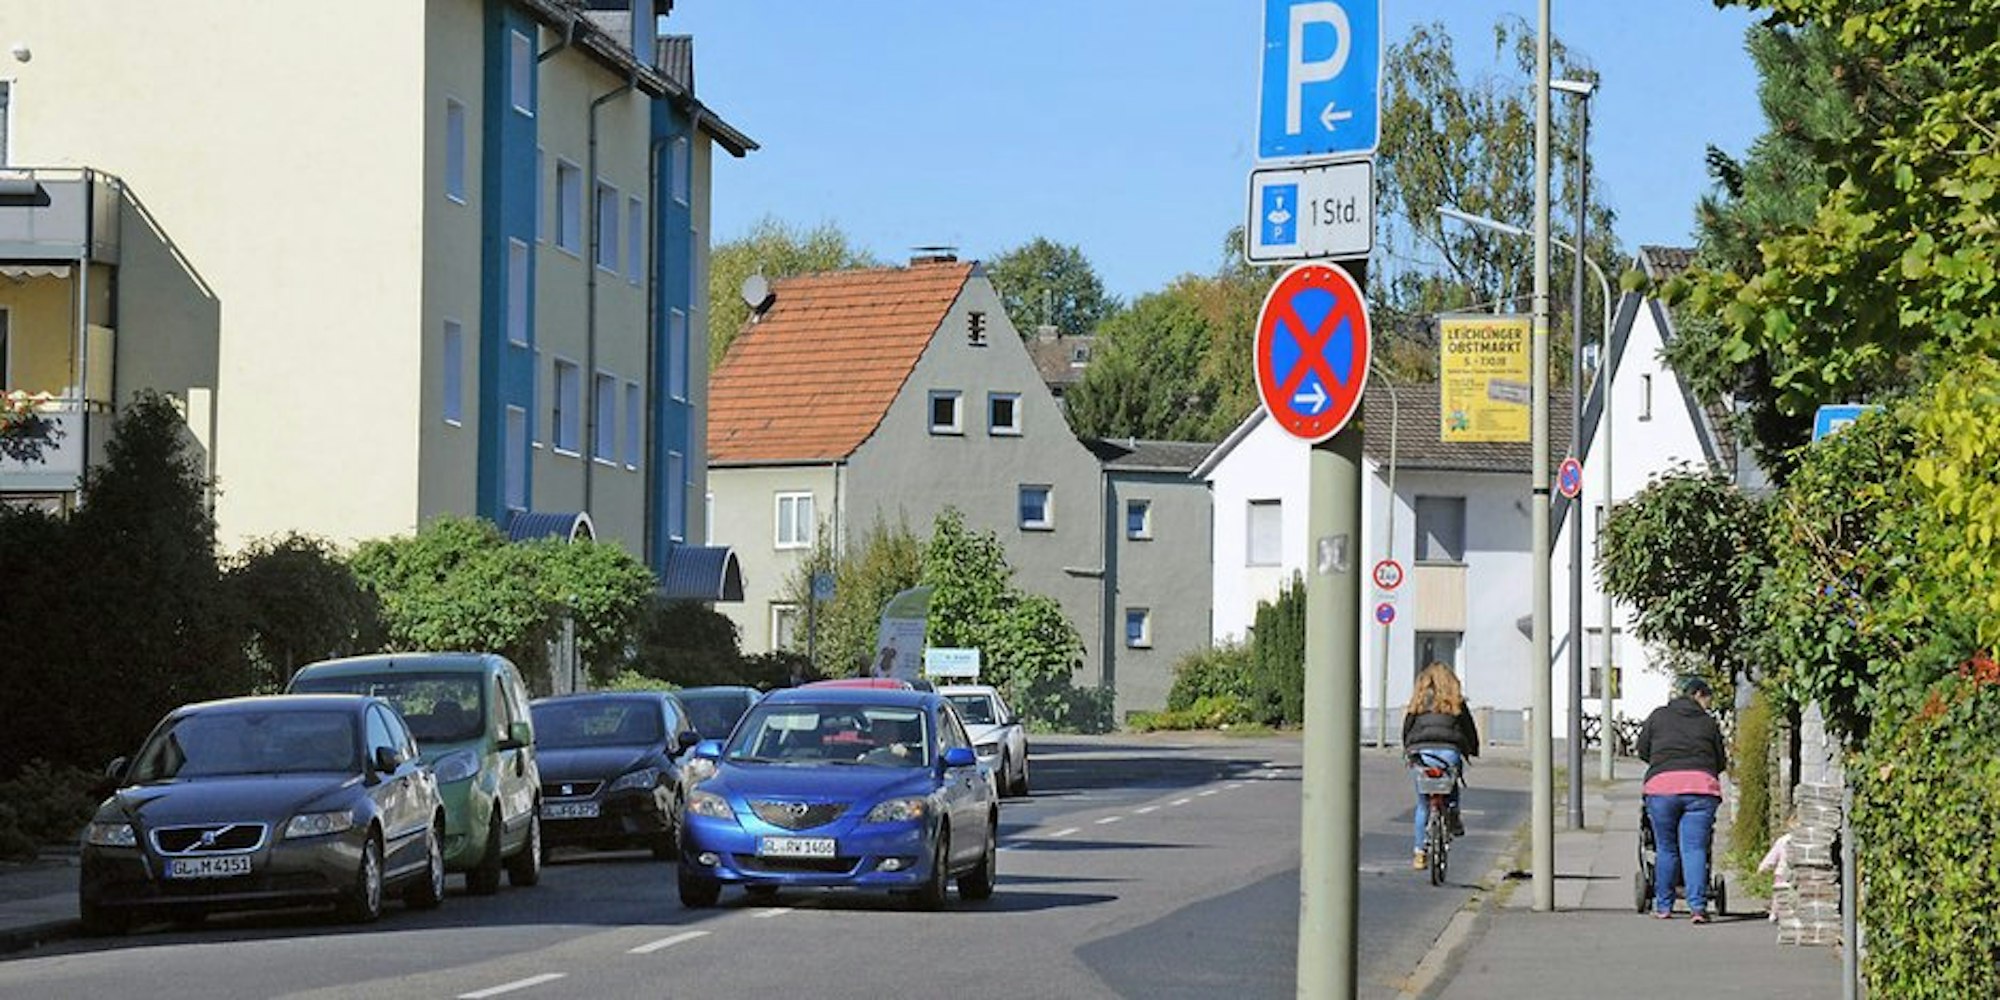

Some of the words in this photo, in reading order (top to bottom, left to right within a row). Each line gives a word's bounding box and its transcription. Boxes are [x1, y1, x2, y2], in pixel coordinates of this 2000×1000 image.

[1285, 0, 1351, 136] P
[1311, 199, 1318, 227] 1
[1323, 195, 1361, 226] Std.
[1447, 327, 1523, 340] LEICHLINGER
[1447, 341, 1522, 354] OBSTMARKT
